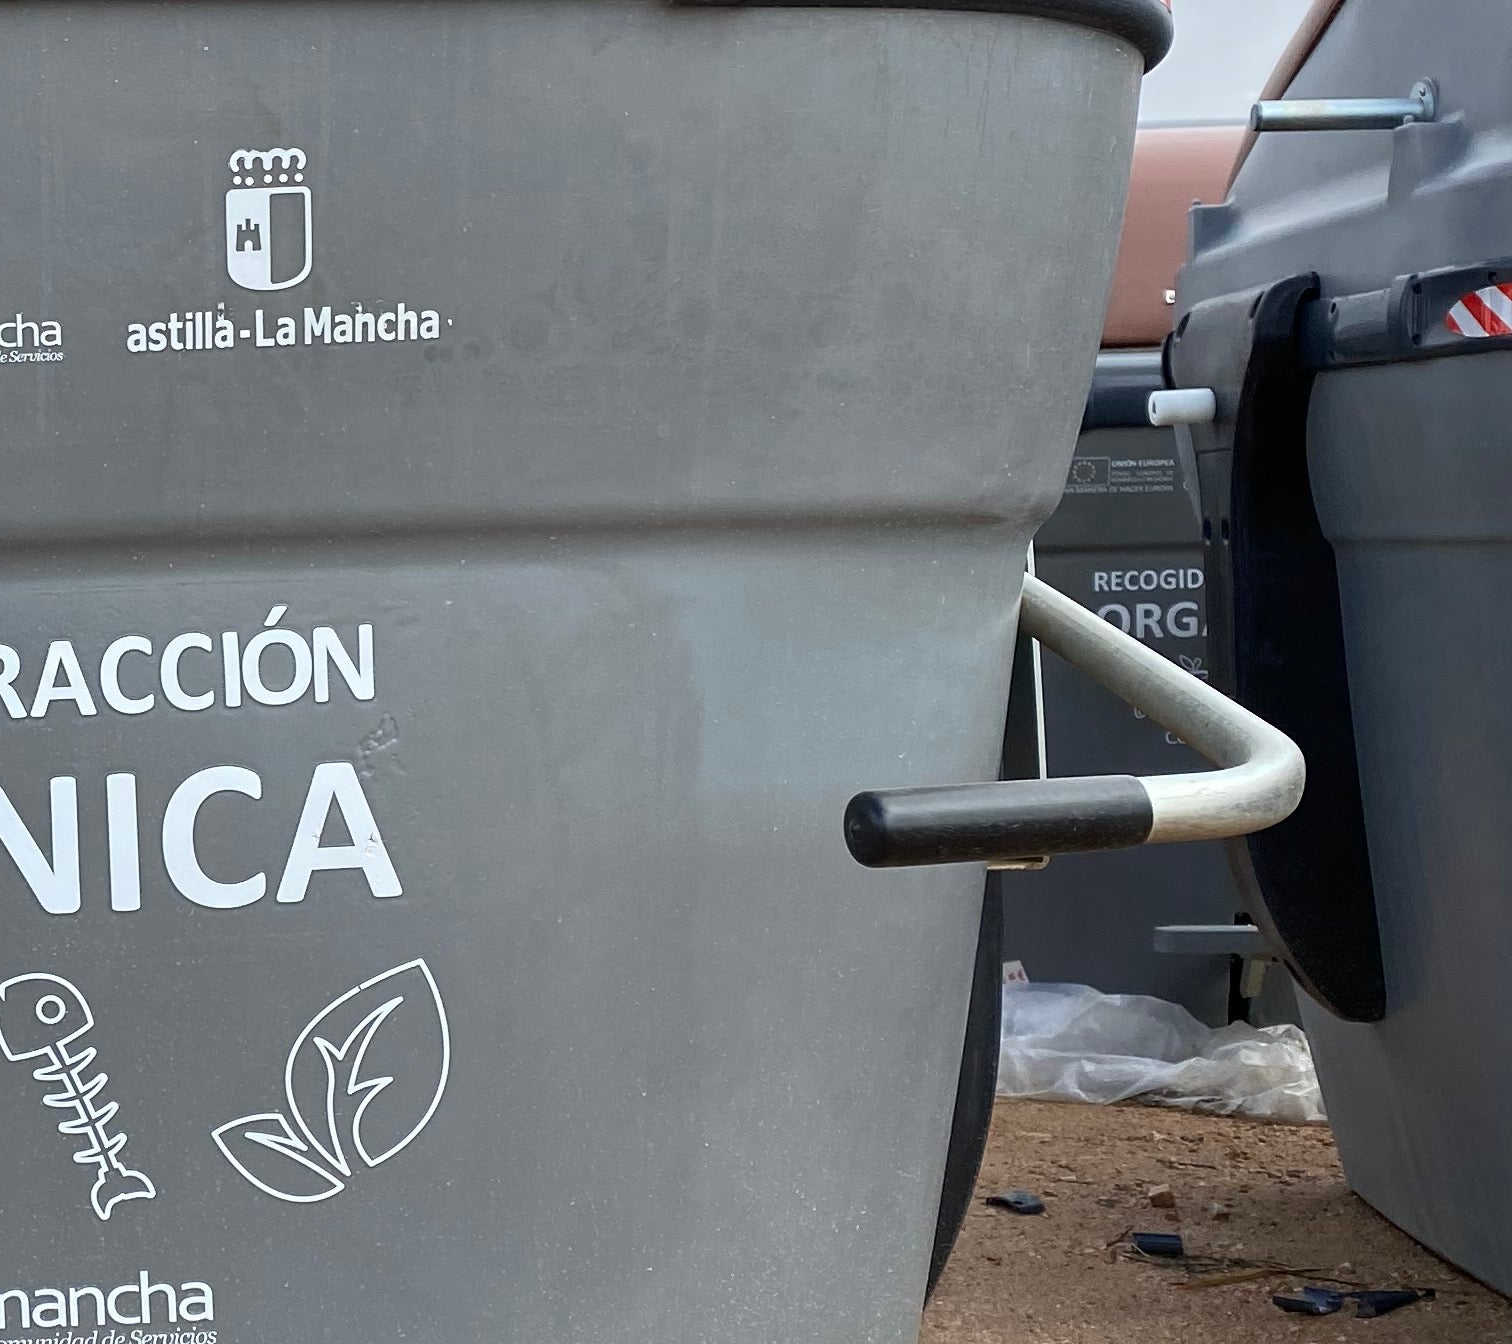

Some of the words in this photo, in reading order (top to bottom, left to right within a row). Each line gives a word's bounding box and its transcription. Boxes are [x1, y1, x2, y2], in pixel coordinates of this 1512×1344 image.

[303, 302, 440, 345] Mancha
[8, 349, 65, 364] Servicios
[1097, 600, 1208, 638] ORG
